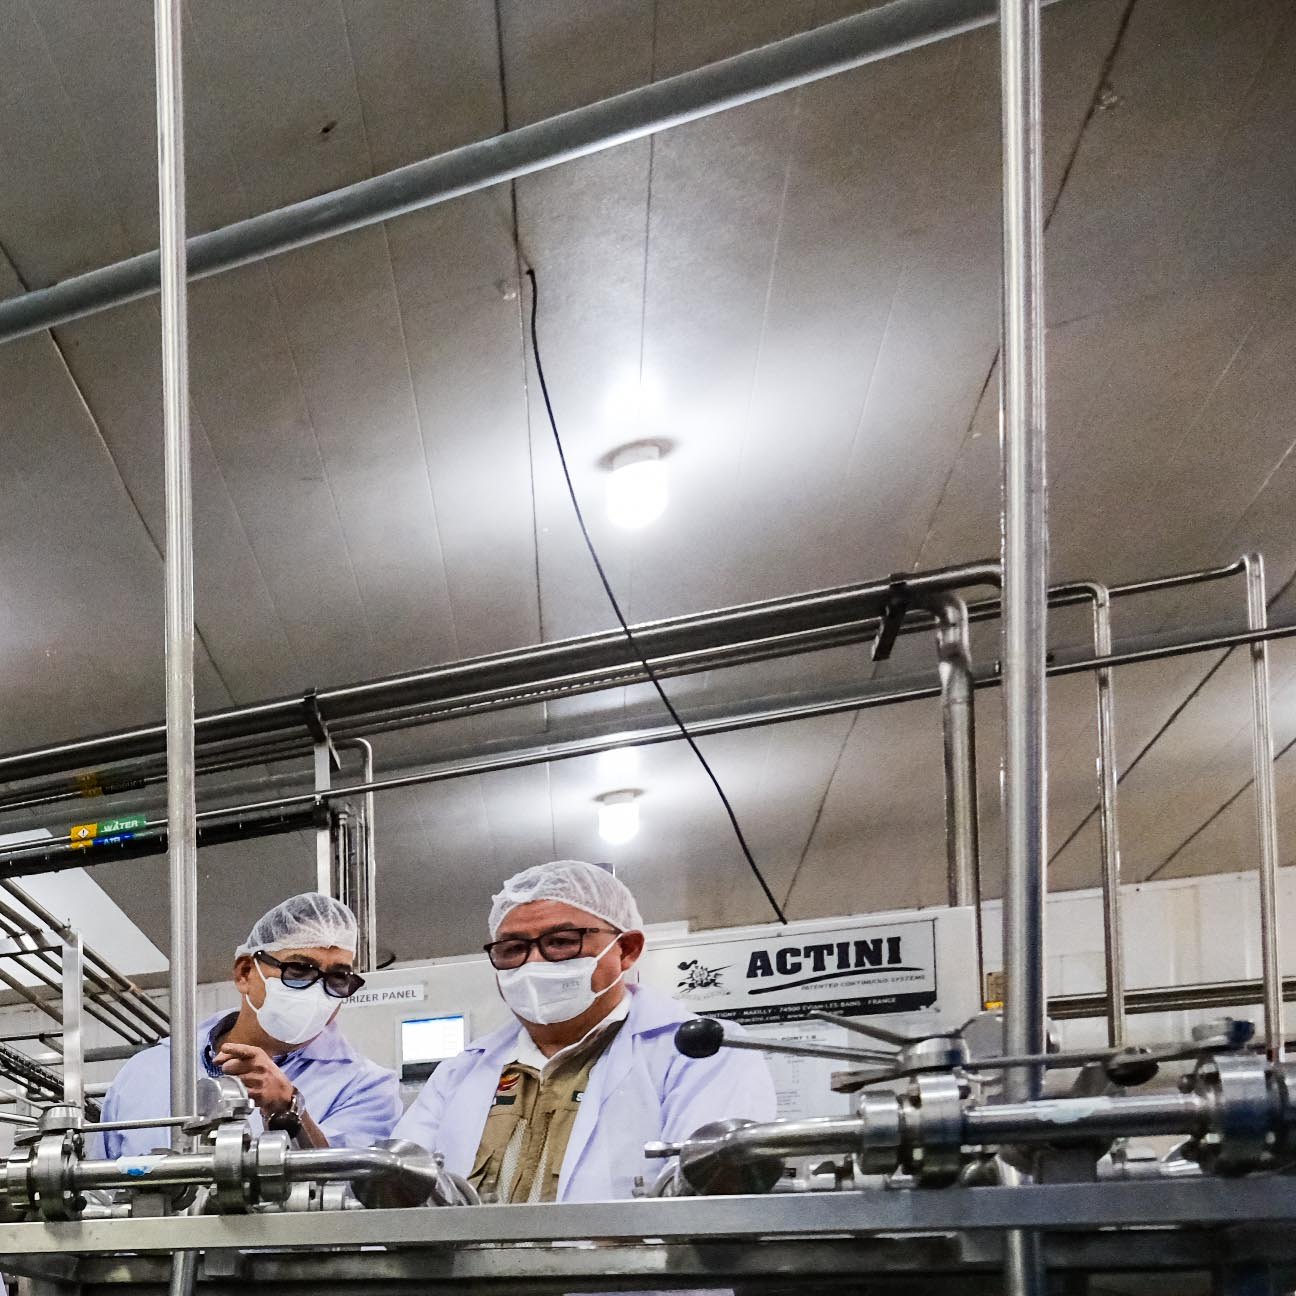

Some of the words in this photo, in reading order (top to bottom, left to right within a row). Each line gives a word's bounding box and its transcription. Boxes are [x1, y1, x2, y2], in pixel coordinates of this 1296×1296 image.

[103, 820, 138, 832] WATER
[746, 936, 902, 979] ACTINI
[892, 974, 926, 982] SYSTEMS
[382, 989, 417, 1001] PANEL
[867, 997, 897, 1005] FRANCE
